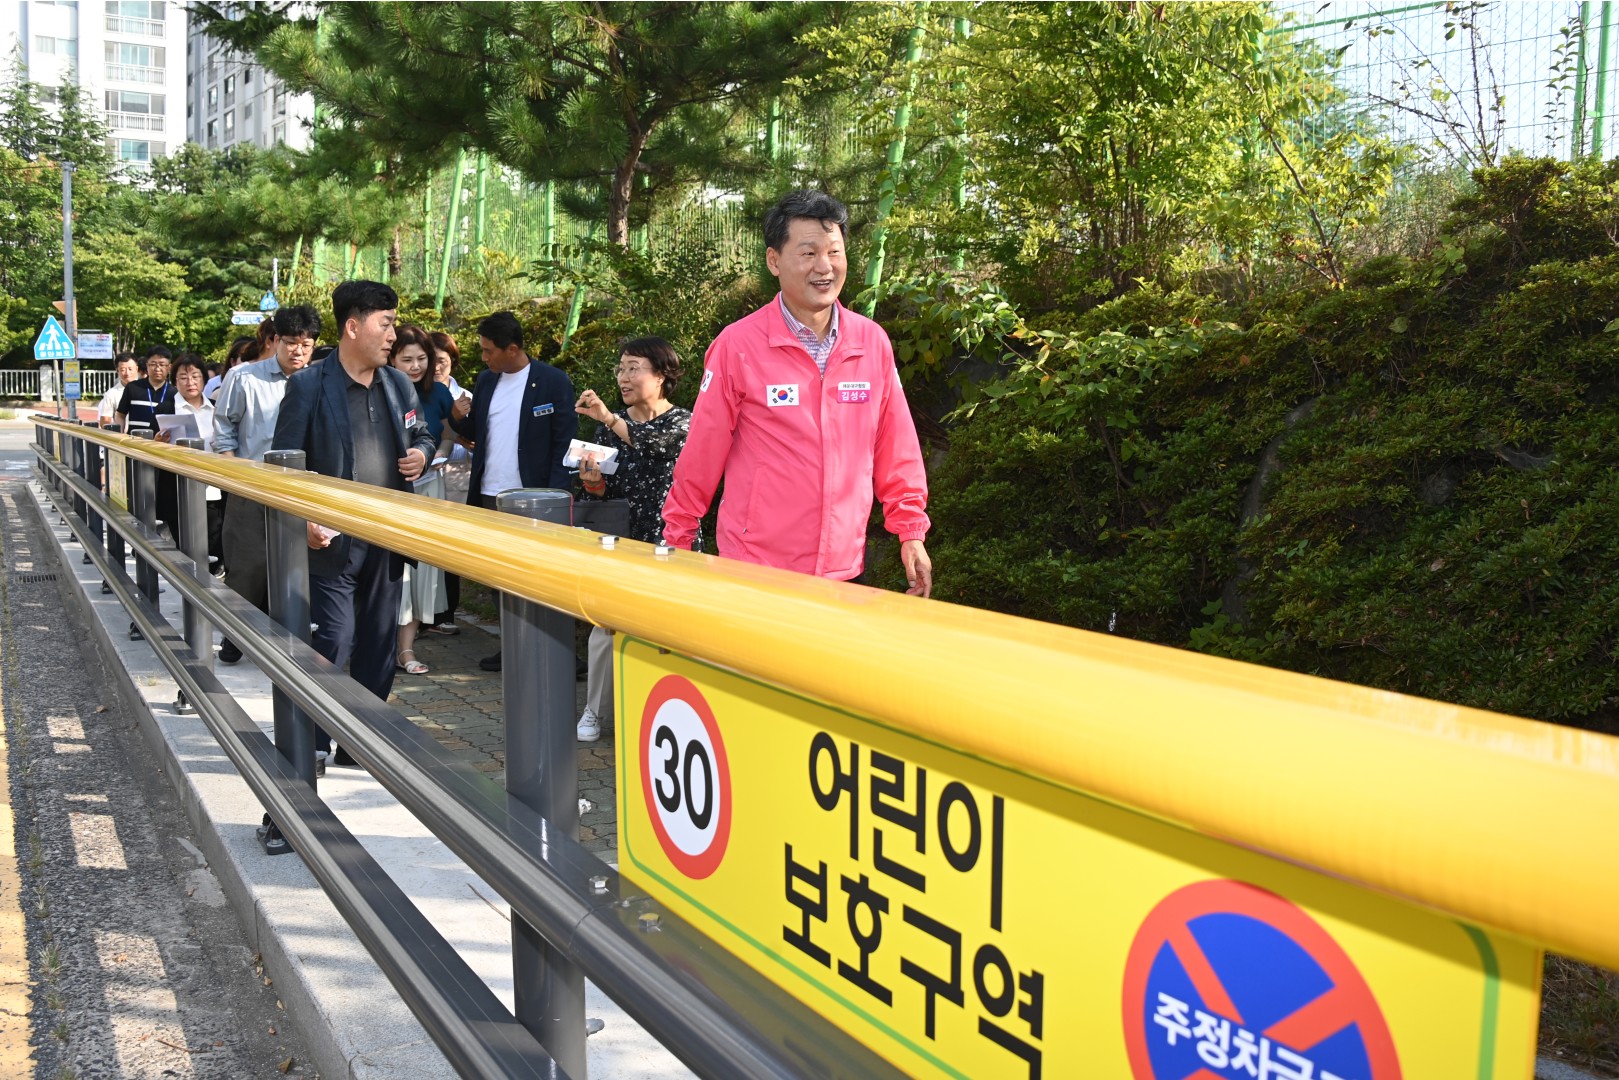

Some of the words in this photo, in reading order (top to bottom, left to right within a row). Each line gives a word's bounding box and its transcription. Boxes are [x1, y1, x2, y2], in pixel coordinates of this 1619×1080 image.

[841, 391, 868, 401] 김성수
[654, 724, 714, 830] 30
[808, 731, 1005, 933] 어린이
[782, 841, 1045, 1080] 보호구역
[1153, 991, 1347, 1080] 주정차금
